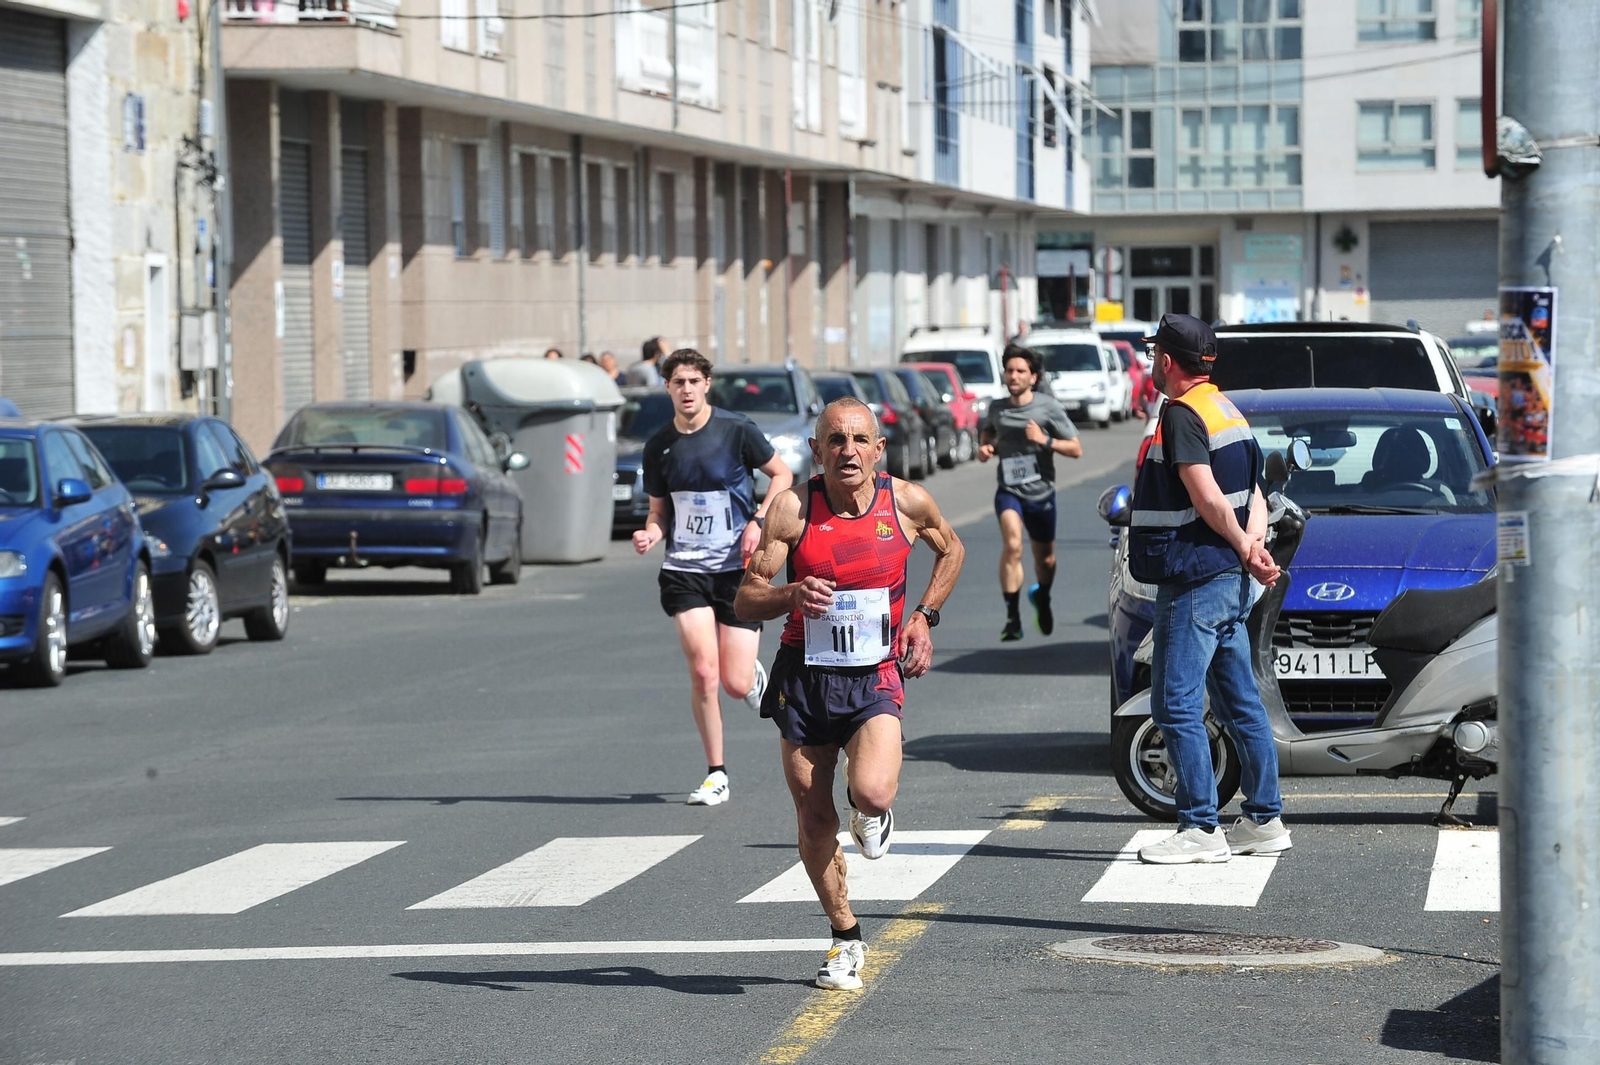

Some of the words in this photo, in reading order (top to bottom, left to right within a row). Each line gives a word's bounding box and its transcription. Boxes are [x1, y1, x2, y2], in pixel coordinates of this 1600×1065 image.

[686, 514, 714, 535] 427
[821, 614, 864, 622] SATURNINO
[831, 625, 855, 652] 111
[1278, 653, 1336, 674] 9411
[1348, 653, 1384, 674] LP
